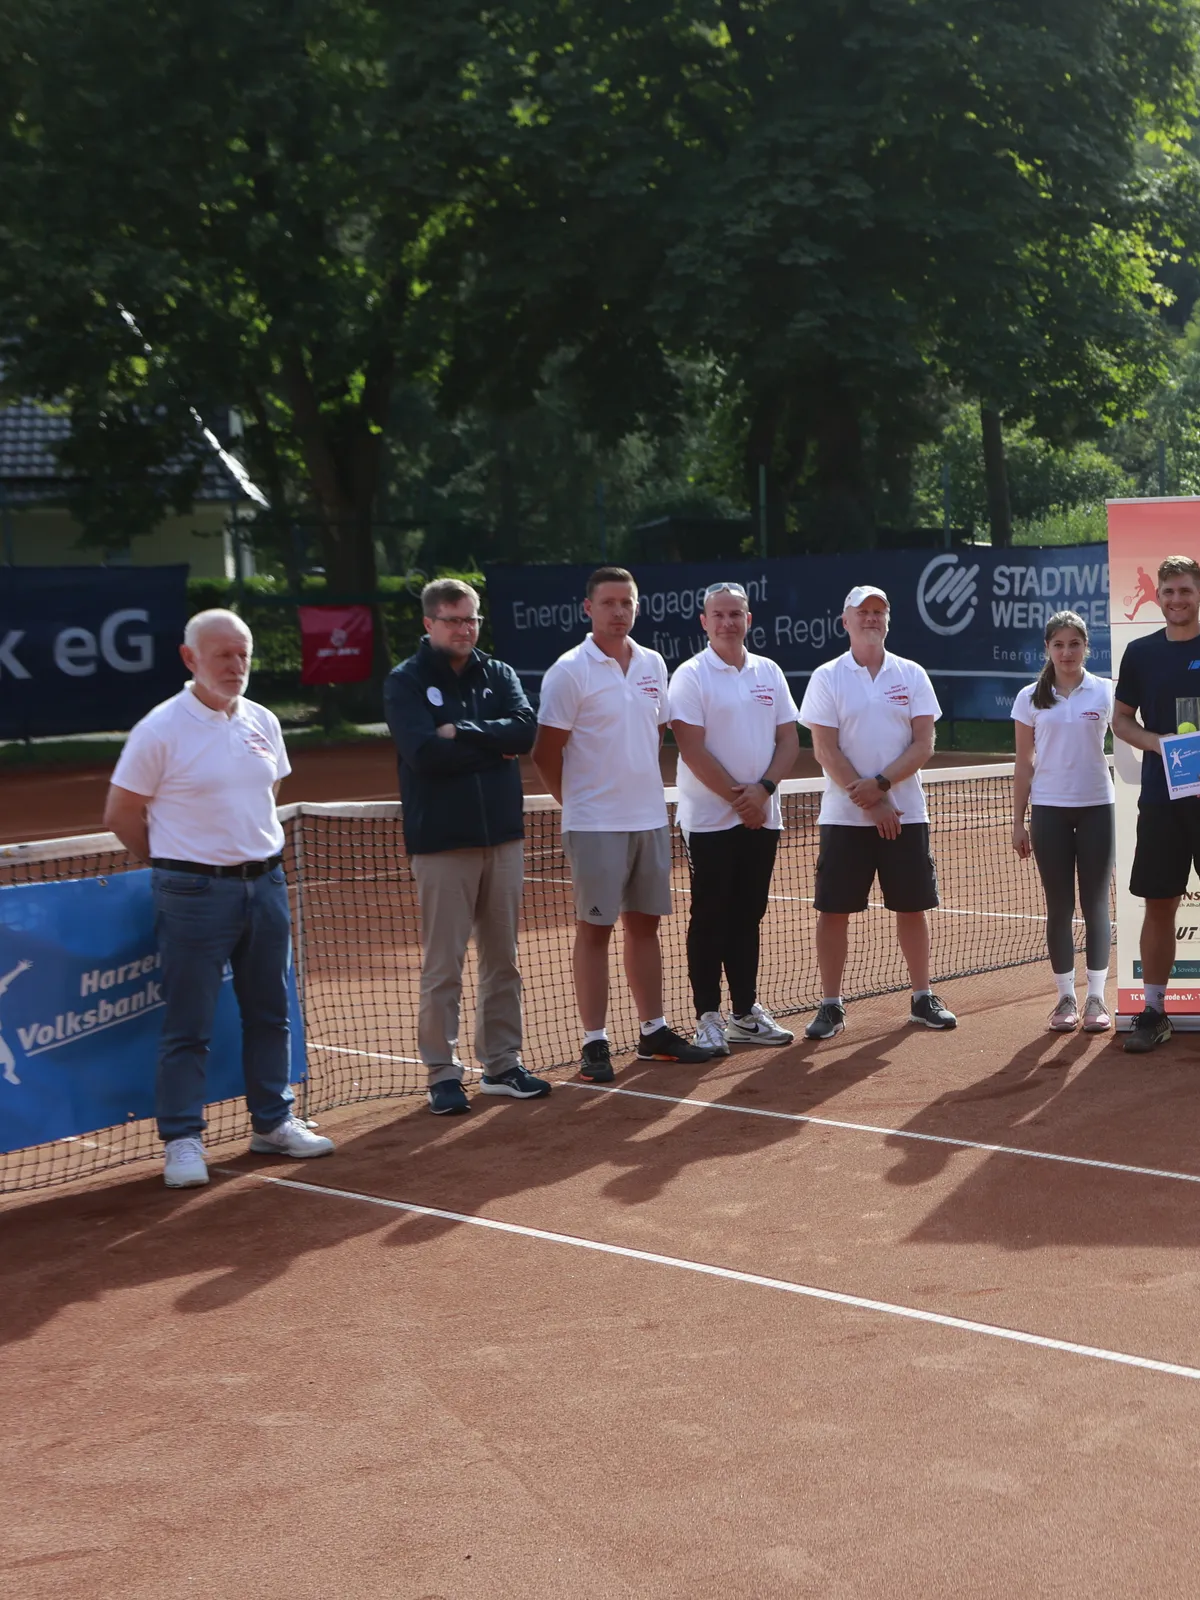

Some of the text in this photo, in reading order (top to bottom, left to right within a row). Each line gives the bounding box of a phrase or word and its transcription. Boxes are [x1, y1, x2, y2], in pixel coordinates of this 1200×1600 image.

[992, 564, 1110, 597] STADTWE
[53, 608, 154, 677] eG
[652, 630, 681, 660] für
[775, 608, 849, 648] Regio
[993, 646, 1046, 665] Energie
[16, 980, 163, 1051] Volksbank
